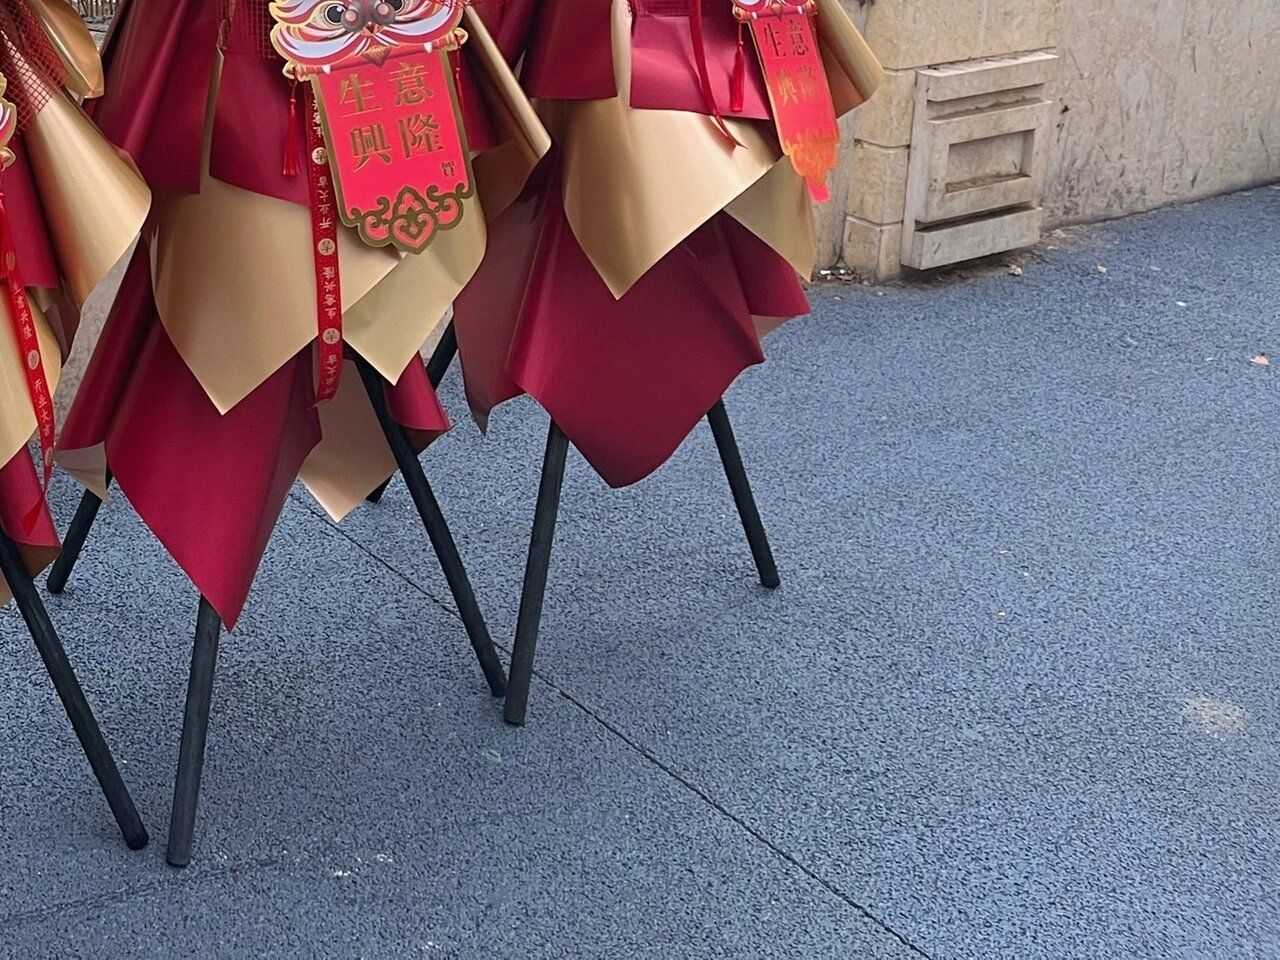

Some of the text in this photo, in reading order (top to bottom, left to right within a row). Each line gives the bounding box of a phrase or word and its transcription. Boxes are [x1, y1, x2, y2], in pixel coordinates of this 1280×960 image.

[337, 61, 433, 116] 生意
[349, 113, 444, 174] 興隆
[318, 176, 332, 229] 开业大吉
